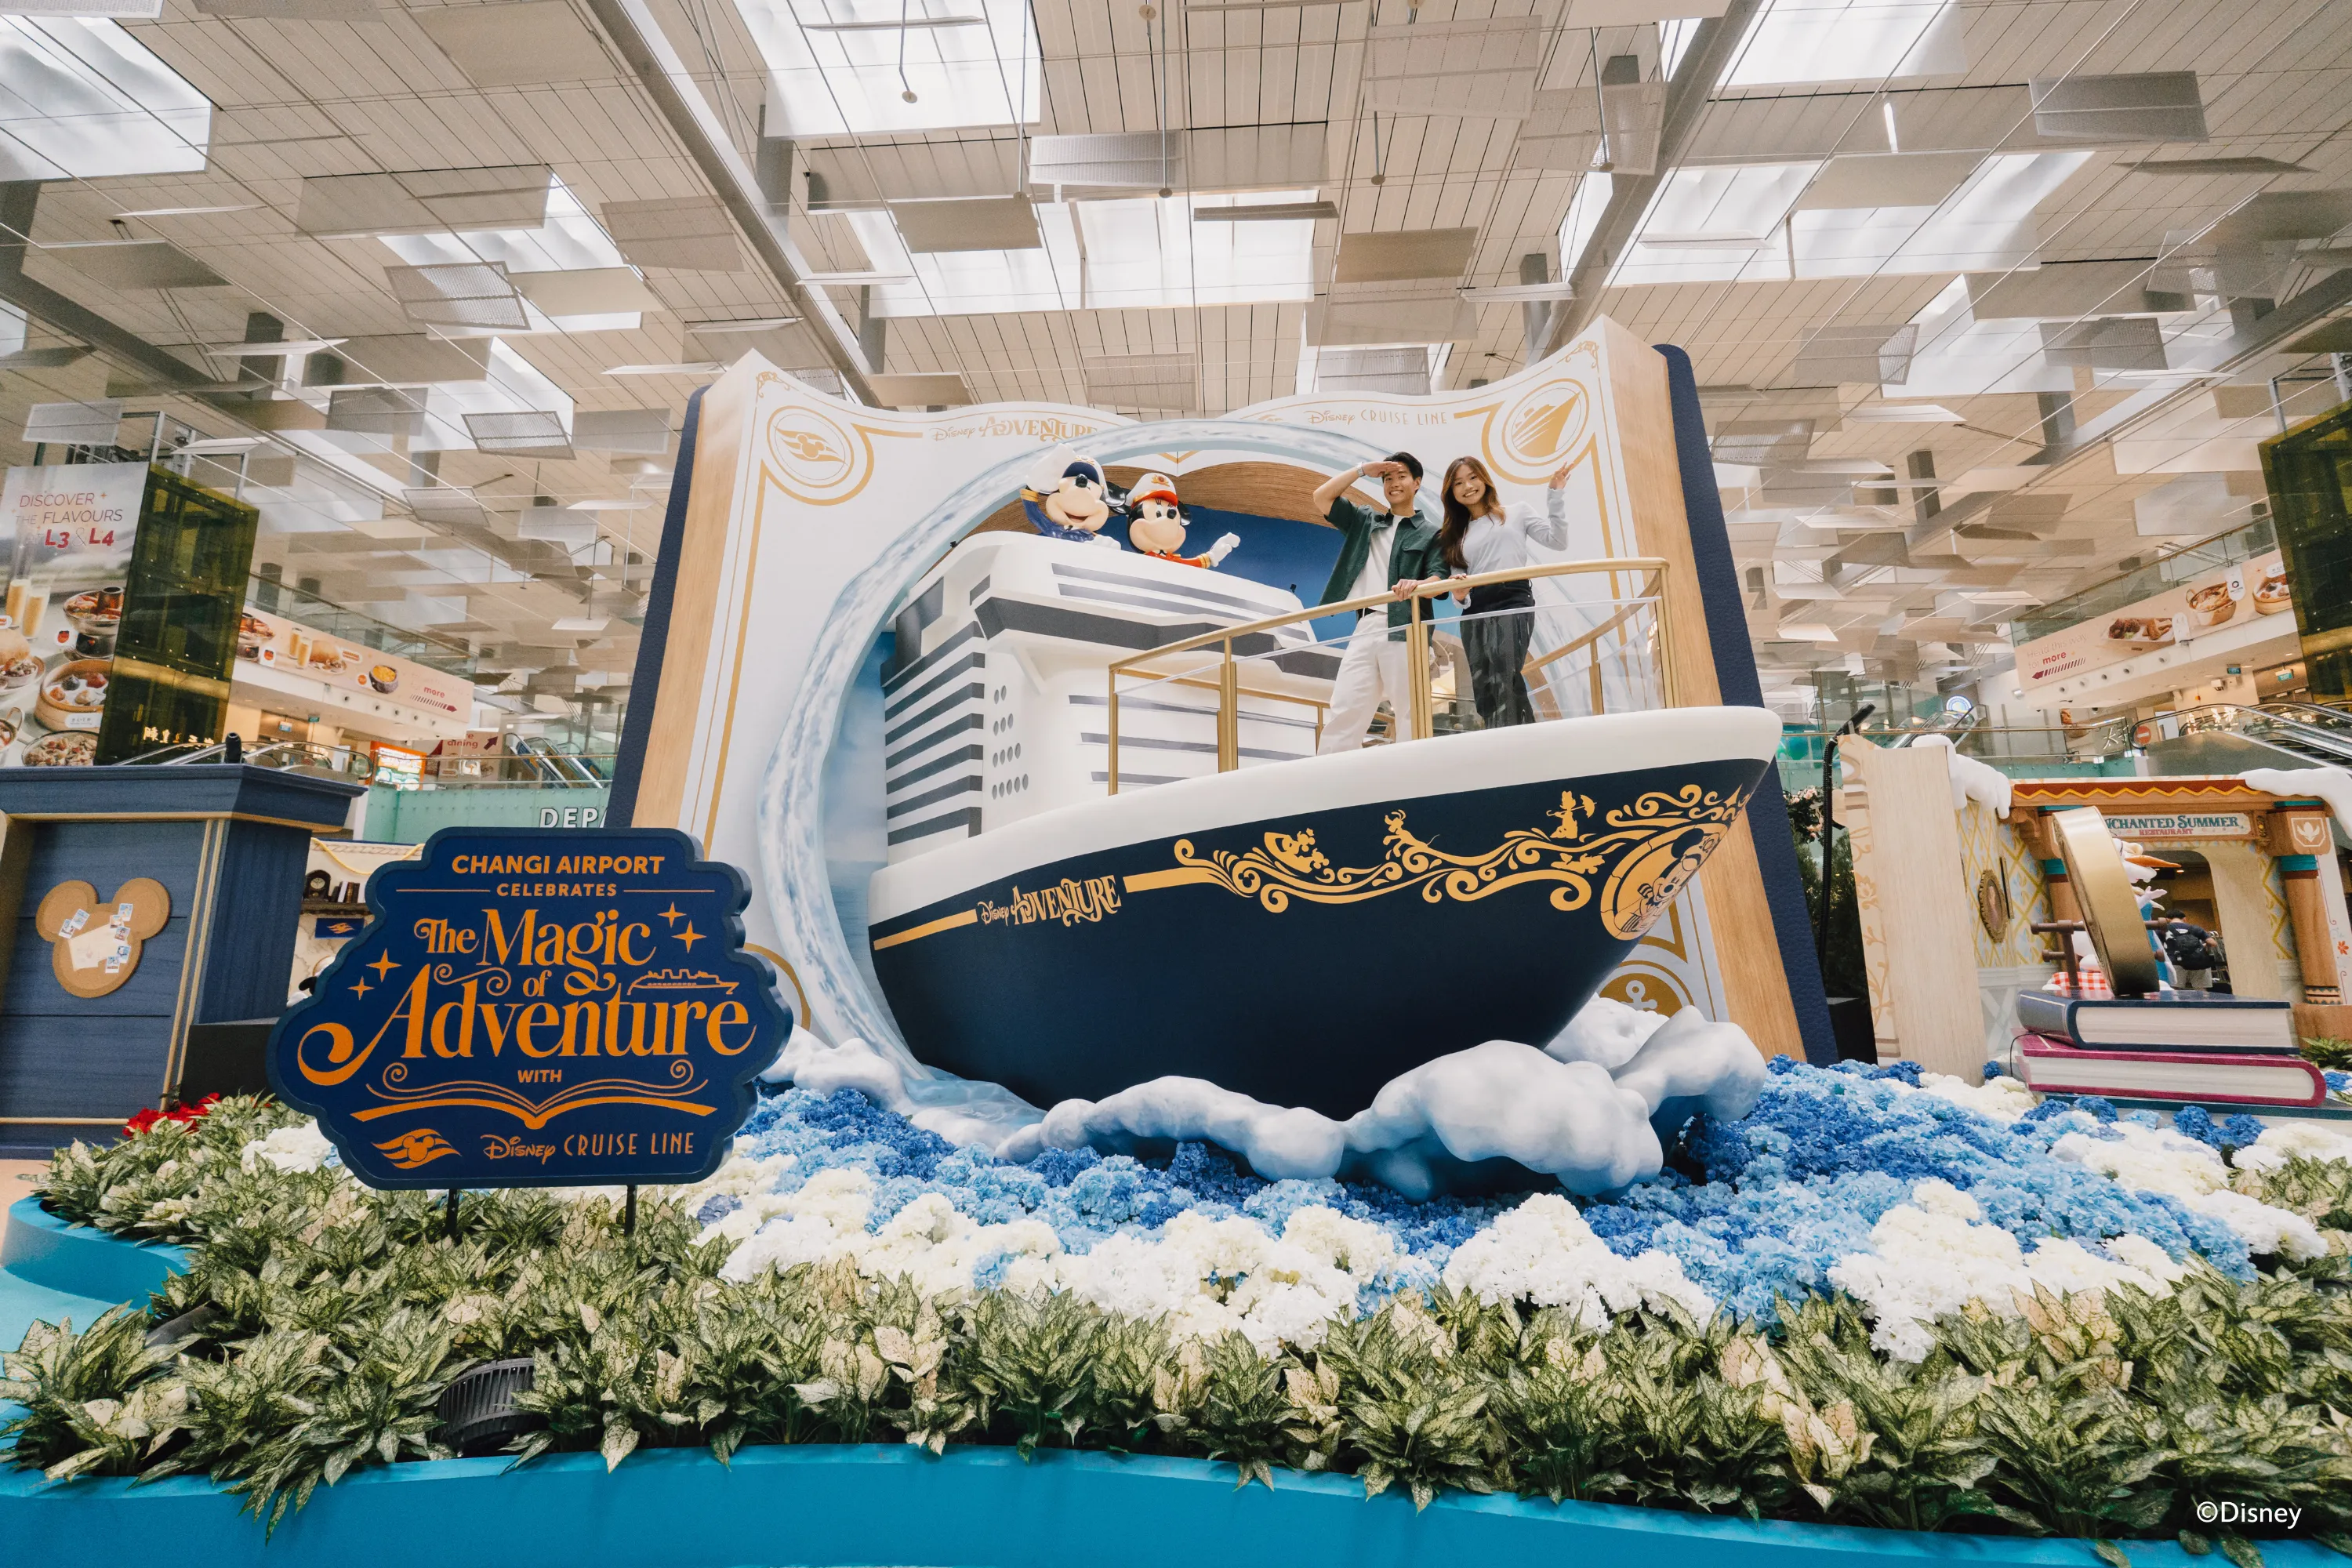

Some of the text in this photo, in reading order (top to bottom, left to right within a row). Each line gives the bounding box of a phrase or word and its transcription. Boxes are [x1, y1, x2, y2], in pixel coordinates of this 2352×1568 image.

[1360, 408, 1409, 426] CRUISE
[1417, 412, 1447, 426] LINE
[19, 492, 96, 508] DISCOVER
[15, 509, 123, 525] THE FLAVOURS
[44, 528, 71, 549] L3
[89, 527, 114, 547] L4
[2051, 640, 2069, 652] this
[2042, 652, 2067, 666] more
[423, 685, 445, 699] more
[539, 807, 607, 829] DEP
[2105, 815, 2240, 829] NCHANTED SUMMER
[2139, 828, 2194, 837] RESTAURANT
[452, 855, 666, 874] CHANGI AIRPORT
[496, 883, 617, 897] CELEBRATES
[1010, 874, 1122, 927] ADVENTURE
[413, 909, 657, 996] The Magic
[522, 969, 553, 997] of
[297, 964, 757, 1087] Adventure
[517, 1069, 563, 1083] WITH
[563, 1133, 639, 1156] CRUISE
[650, 1132, 695, 1155] LINE
